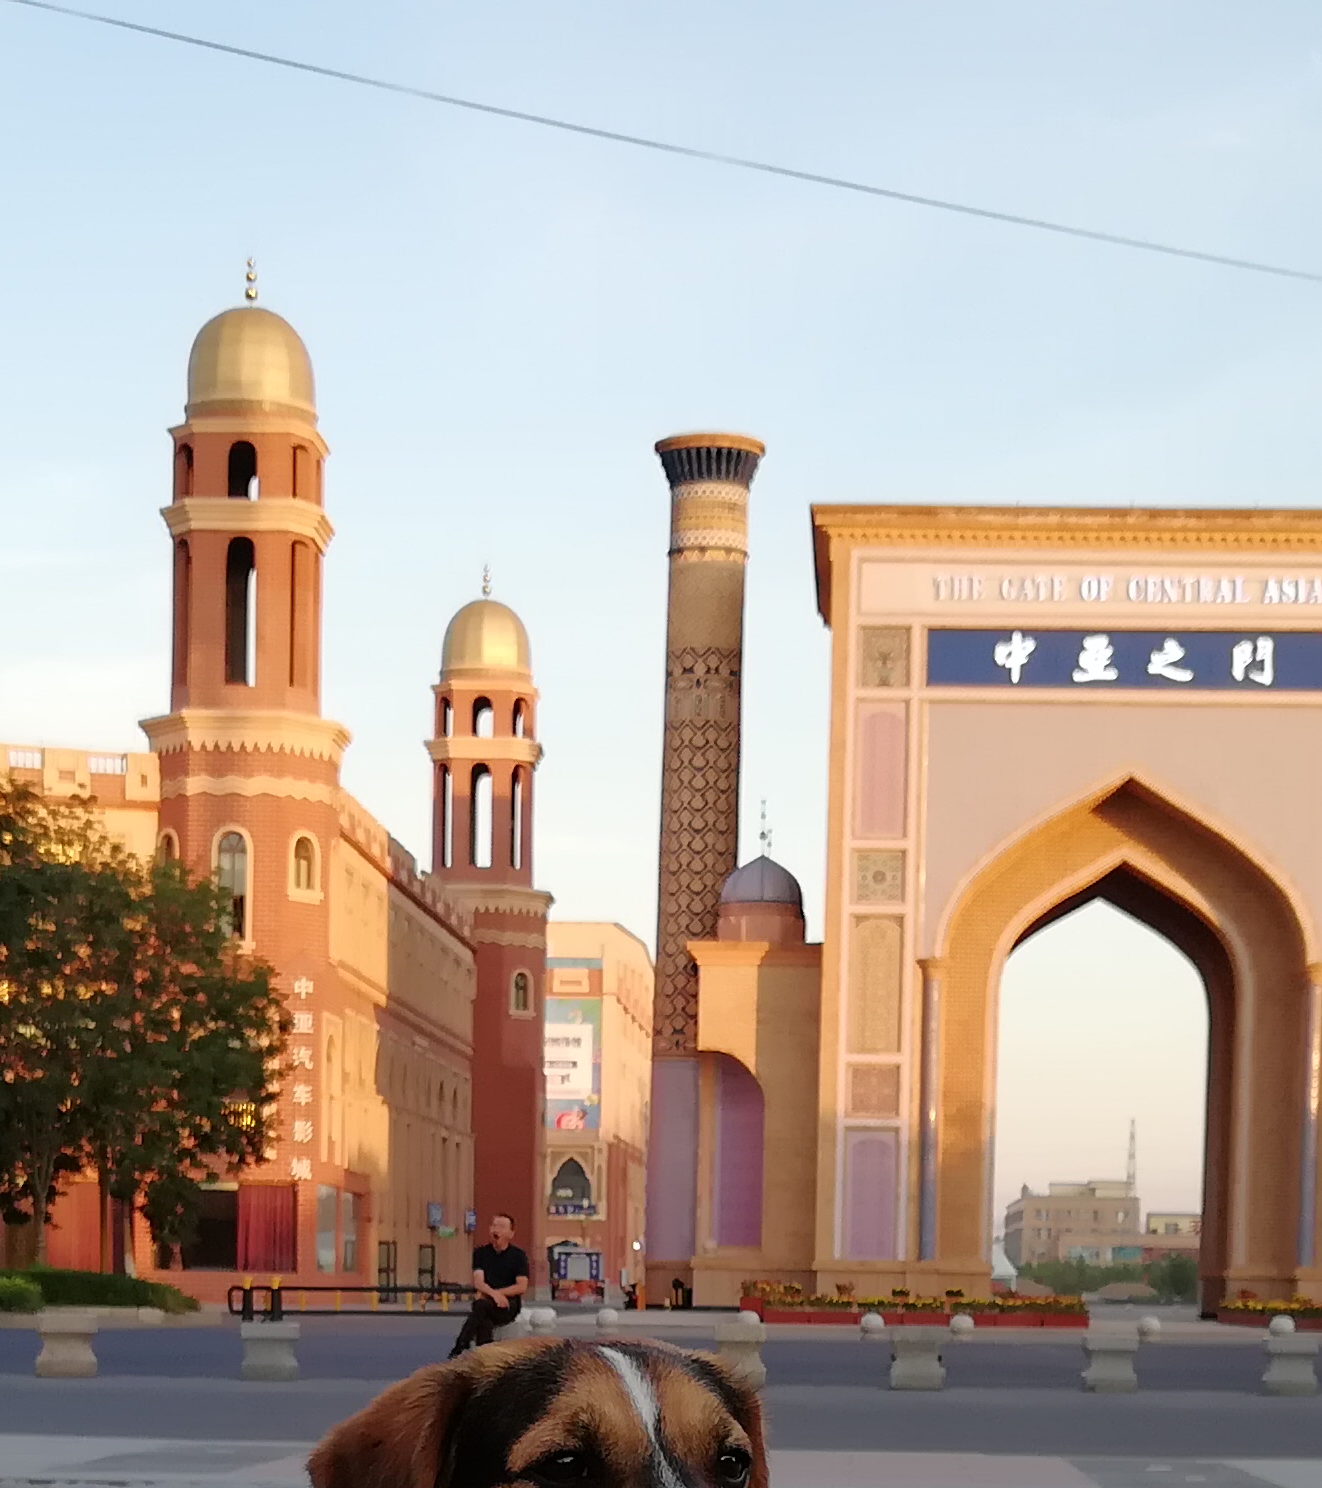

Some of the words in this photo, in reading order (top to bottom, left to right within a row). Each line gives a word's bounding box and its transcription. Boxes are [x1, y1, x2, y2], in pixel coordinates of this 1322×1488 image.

[934, 575, 985, 601] THE
[1000, 576, 1067, 602] GATE
[1079, 574, 1114, 602] OF
[1128, 574, 1251, 604] CENTRAL
[290, 976, 315, 1181] 中亚汽车影城
